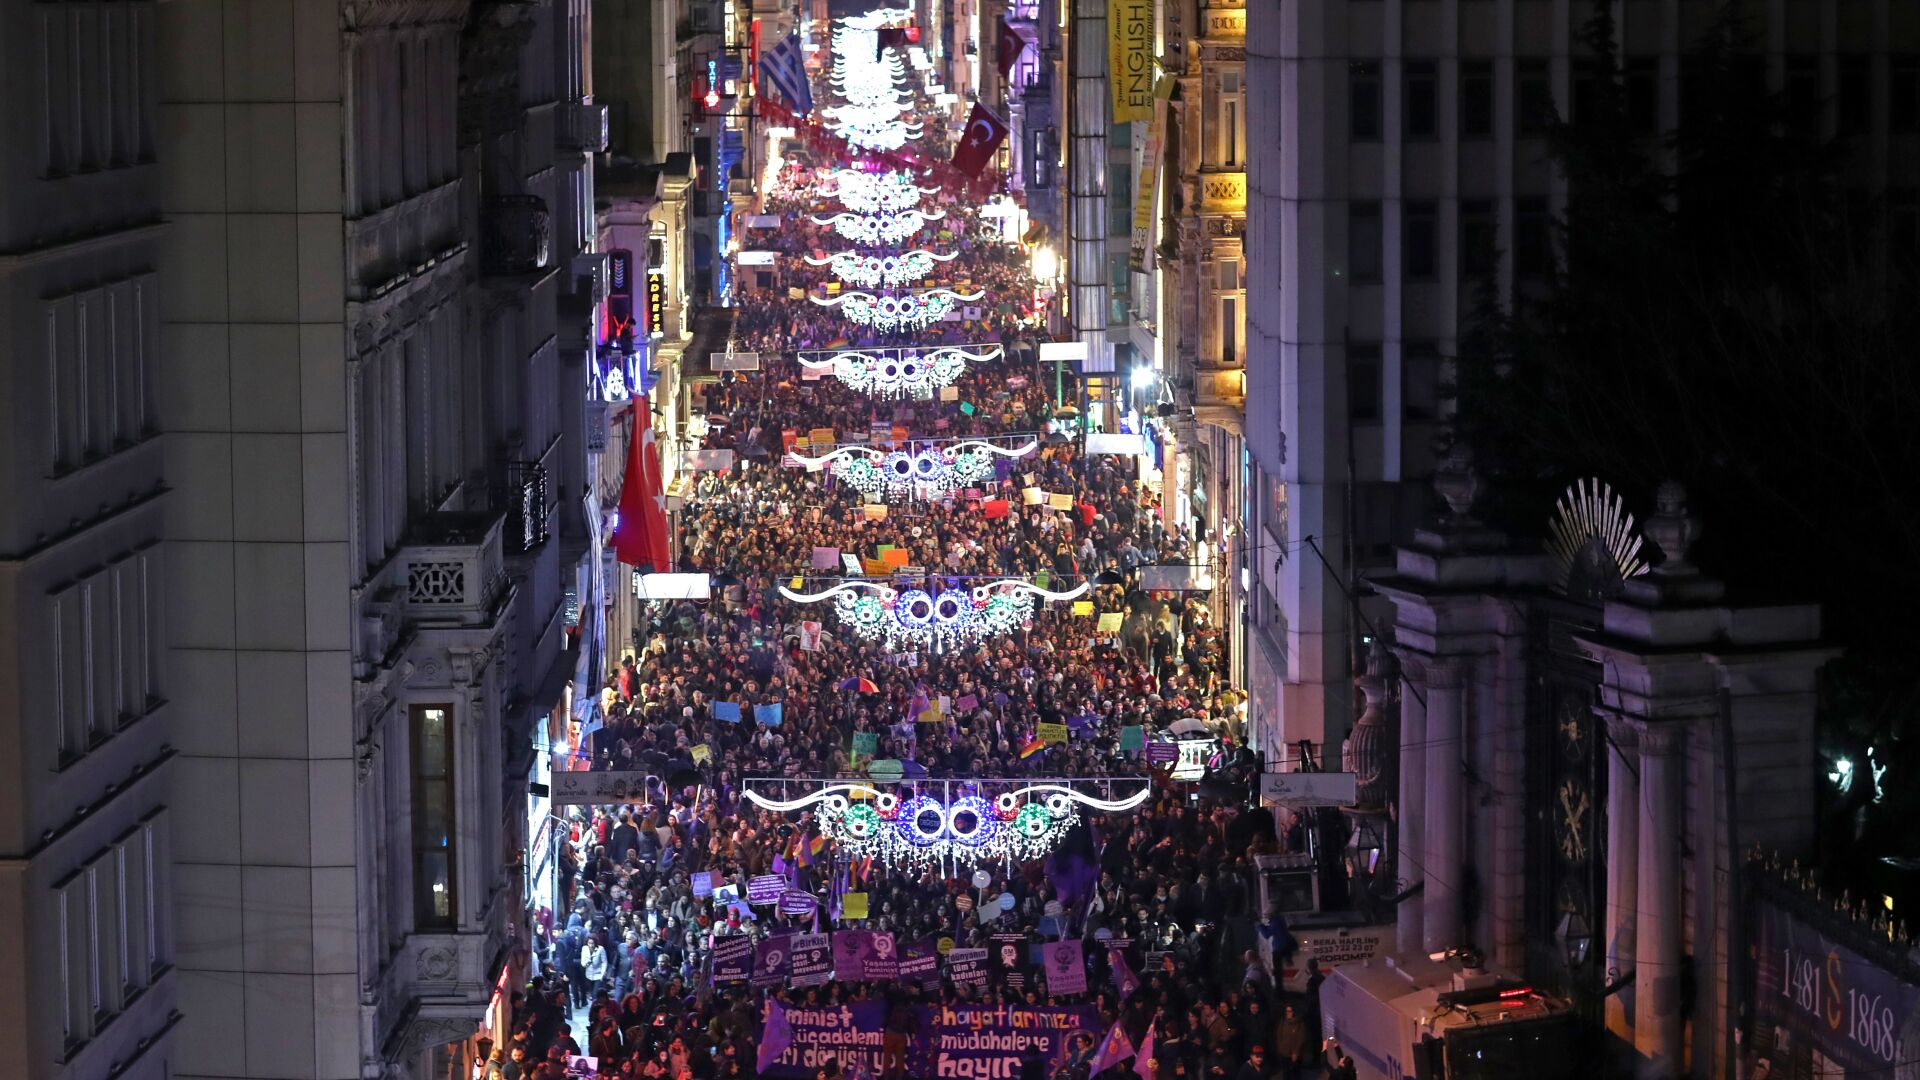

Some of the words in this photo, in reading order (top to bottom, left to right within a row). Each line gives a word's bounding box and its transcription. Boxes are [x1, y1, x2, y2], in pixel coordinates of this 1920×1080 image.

[1128, 6, 1144, 107] ENGLISH
[649, 273, 661, 333] ADRESS
[1313, 938, 1336, 946] BERA
[953, 963, 969, 973] tüm
[761, 1005, 853, 1027] minist
[942, 1005, 1080, 1030] hayatlarımıza
[1782, 949, 1822, 1018] 1481
[1827, 951, 1842, 1029] S
[1849, 988, 1895, 1062] 1868
[937, 1052, 1023, 1080] hayır
